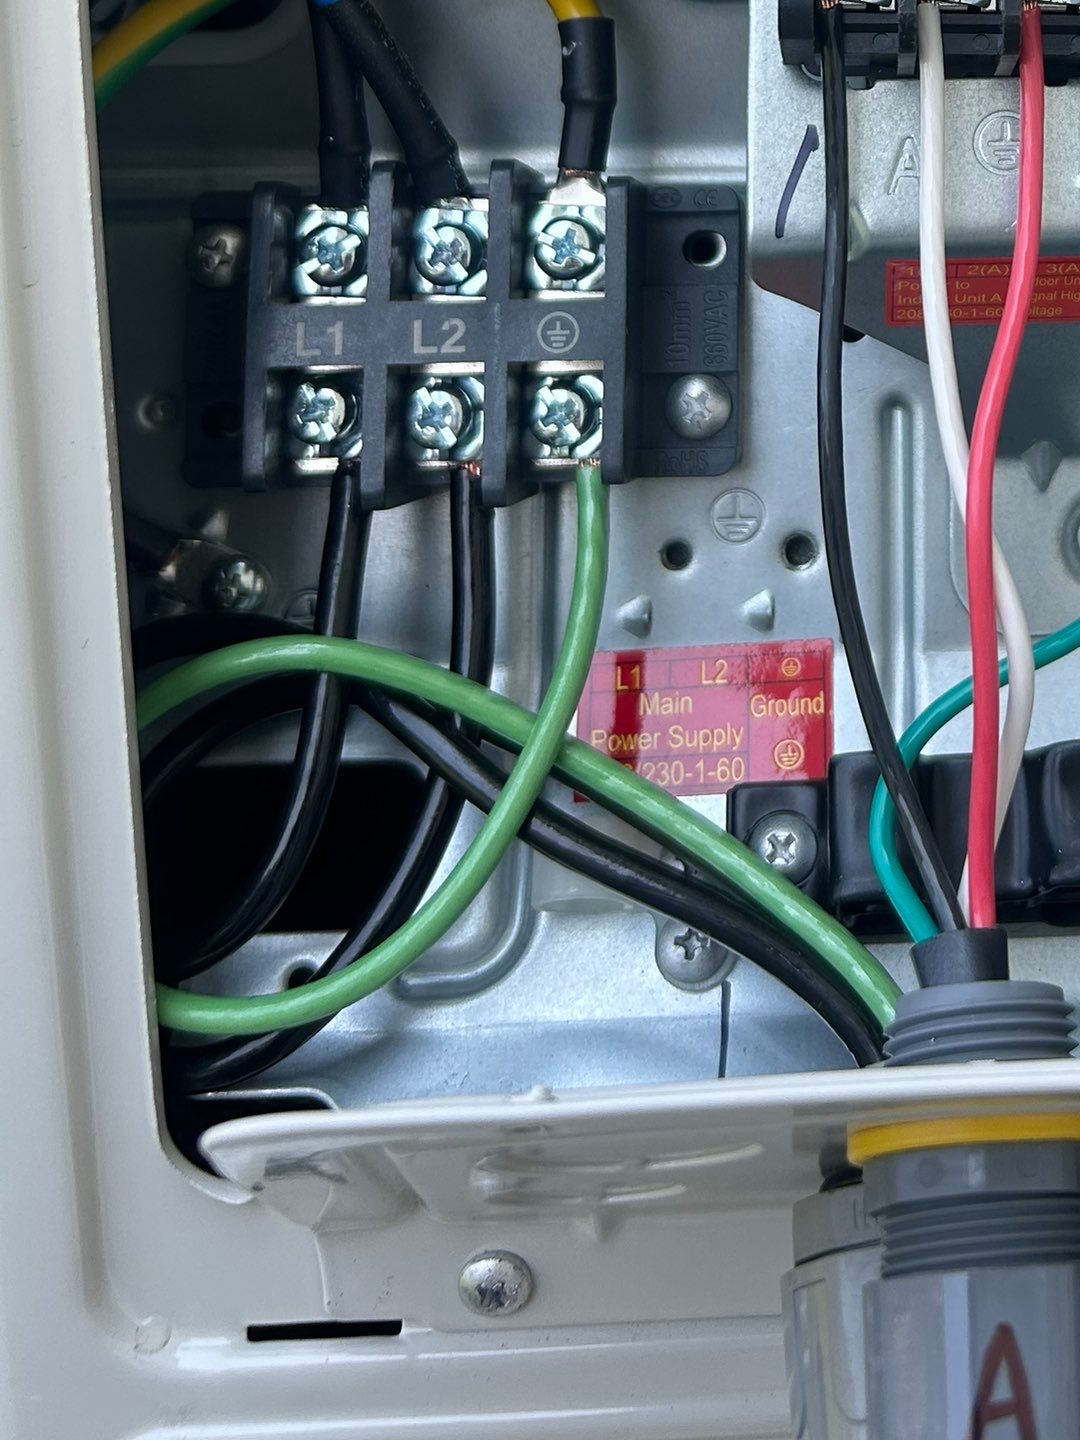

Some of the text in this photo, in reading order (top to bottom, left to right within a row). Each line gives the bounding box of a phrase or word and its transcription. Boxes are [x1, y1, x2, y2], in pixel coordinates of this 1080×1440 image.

[967, 264, 1010, 276] 2(A)
[955, 280, 970, 290] to
[955, 293, 1002, 304] Unit A
[1028, 305, 1063, 317] oltage
[295, 317, 467, 357] L1 L2
[615, 659, 729, 690] L1 L2
[639, 691, 825, 717] Main Ground
[591, 724, 744, 752] Power Supply
[966, 1320, 1040, 1440] A
